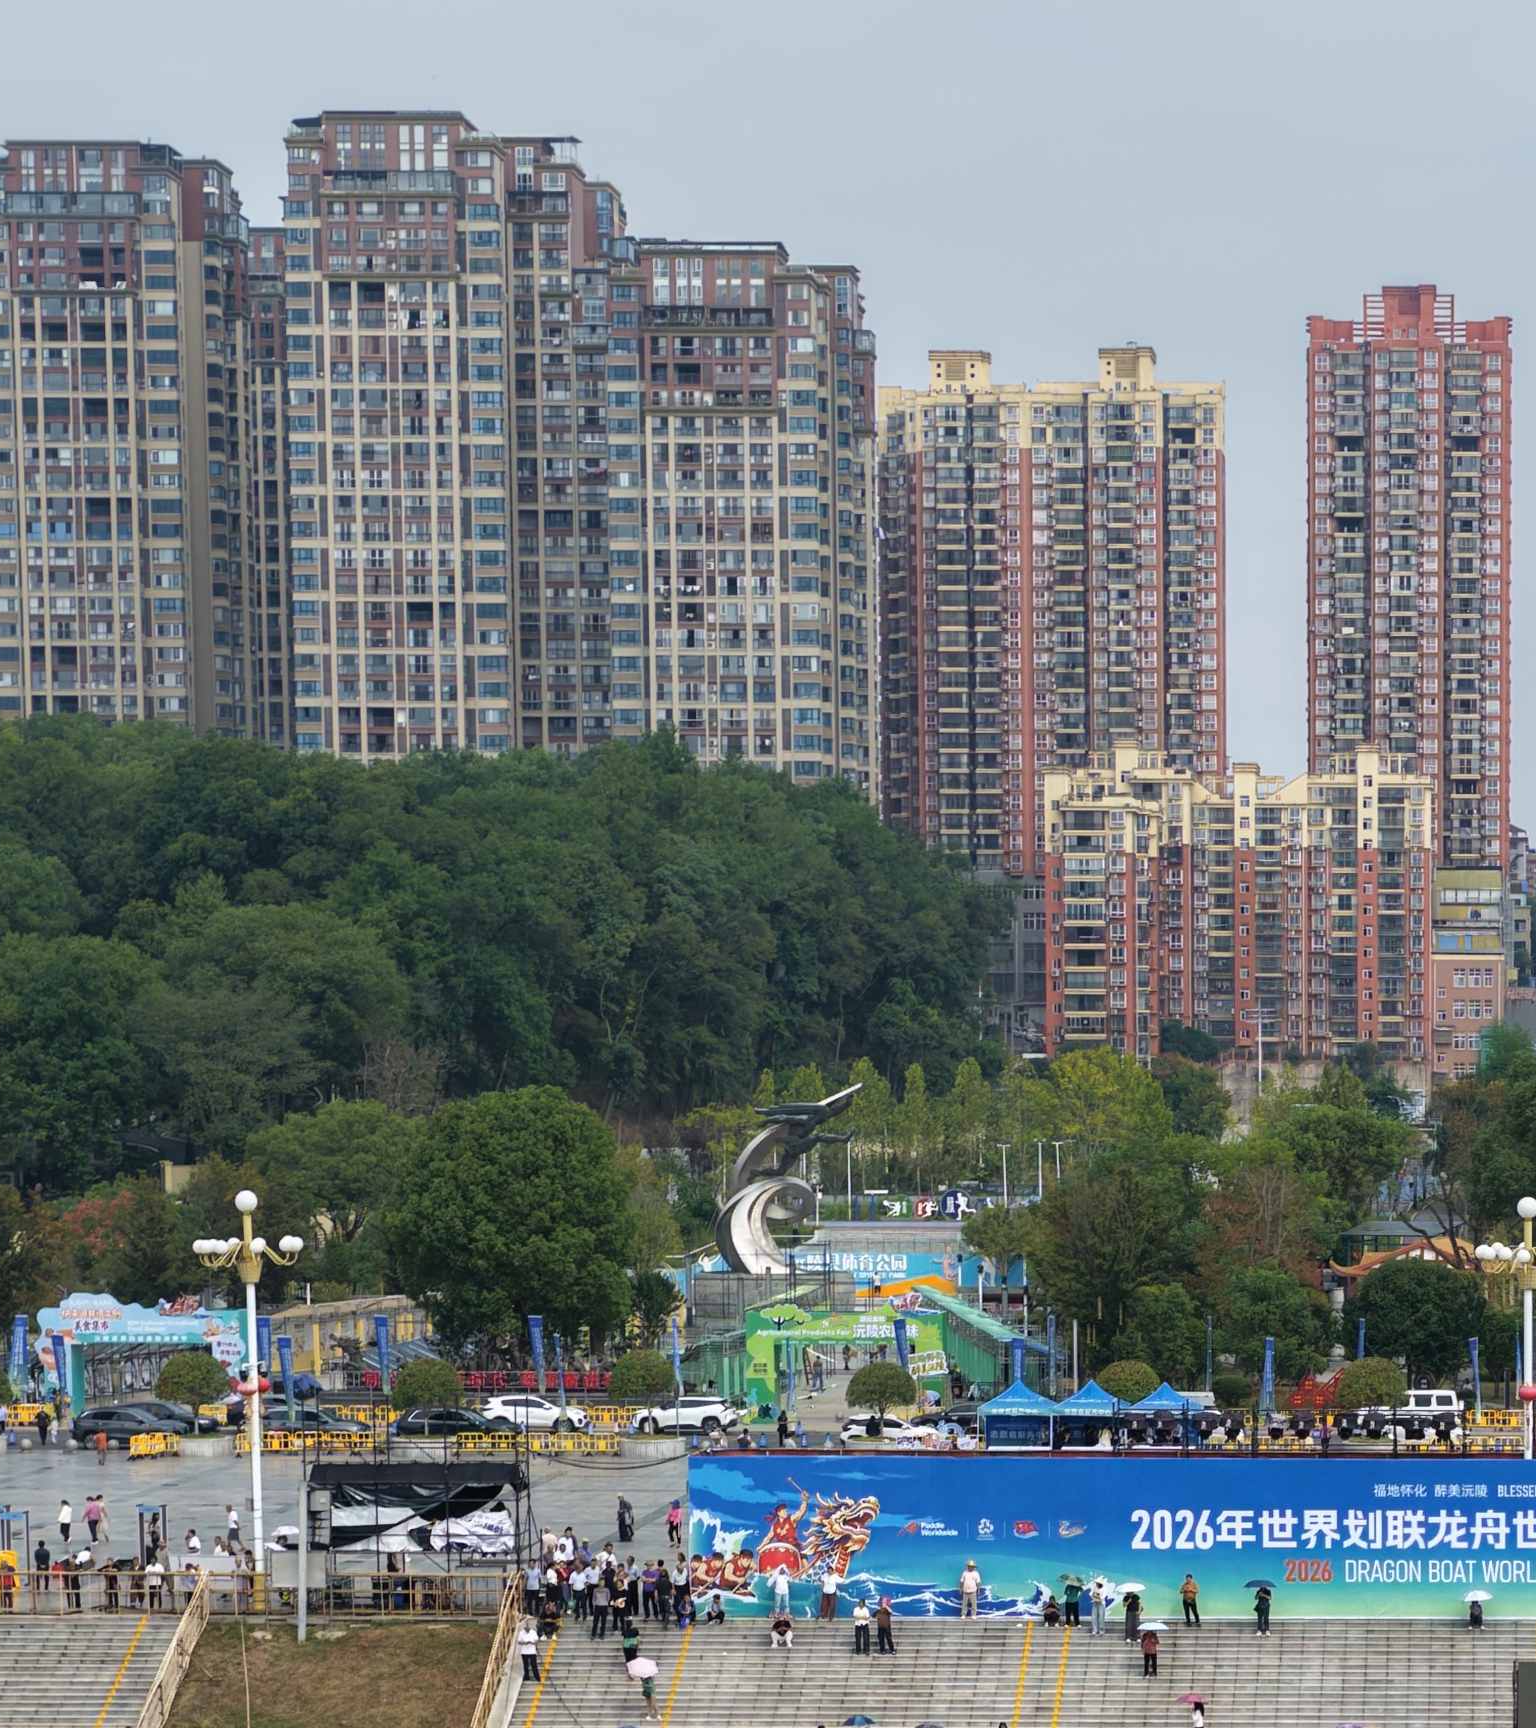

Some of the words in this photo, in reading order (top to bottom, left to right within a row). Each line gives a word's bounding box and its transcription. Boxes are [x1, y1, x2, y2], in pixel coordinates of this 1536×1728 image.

[852, 1324, 920, 1339] 沅陵农味
[1373, 1483, 1428, 1497] 福地怀化
[1434, 1483, 1489, 1497] 醉美沅陵
[1285, 1560, 1332, 1584] 2026
[1345, 1560, 1421, 1583] DRAGON
[1429, 1560, 1476, 1583] BOAT
